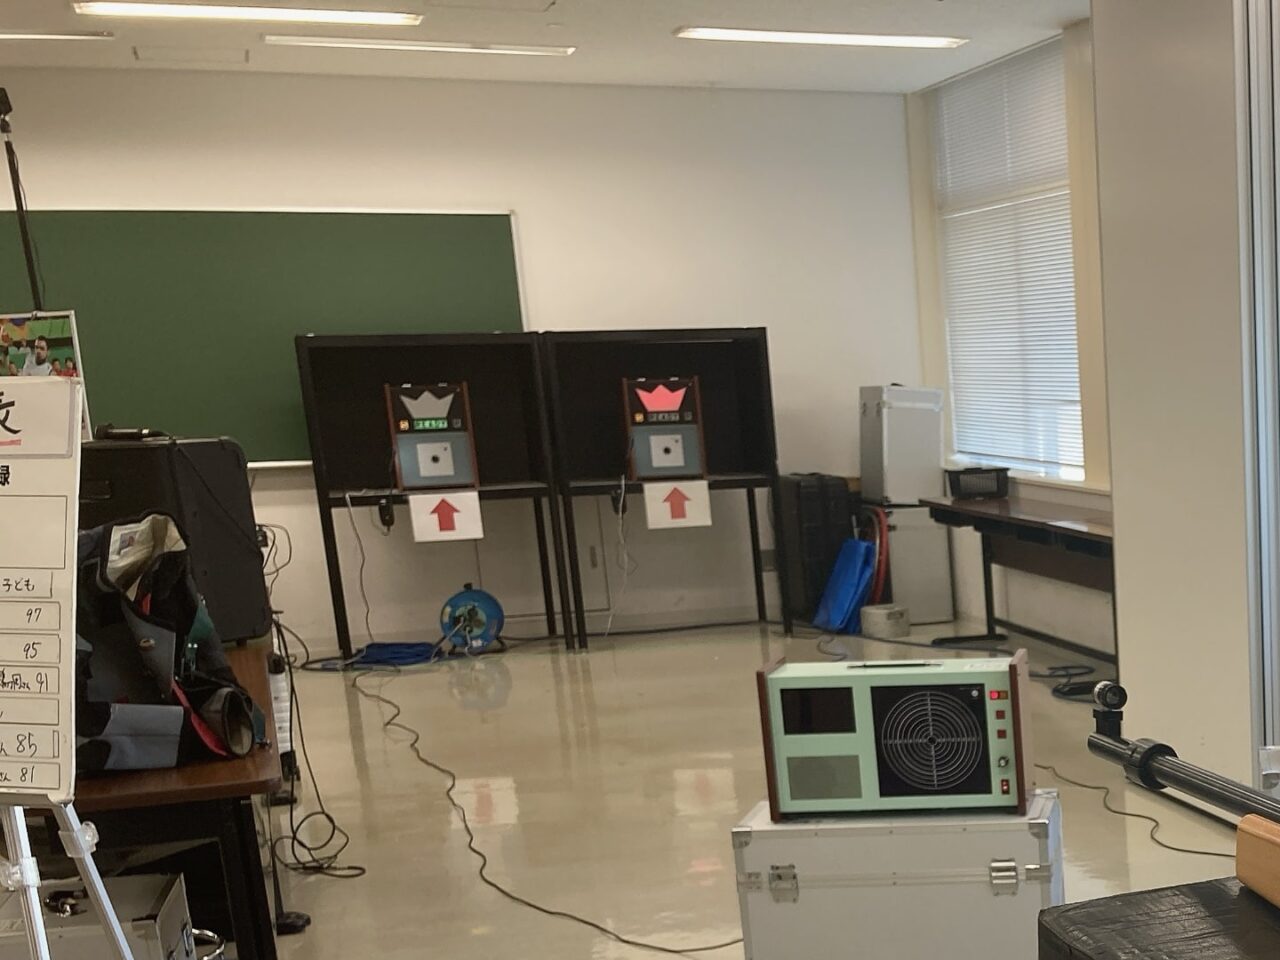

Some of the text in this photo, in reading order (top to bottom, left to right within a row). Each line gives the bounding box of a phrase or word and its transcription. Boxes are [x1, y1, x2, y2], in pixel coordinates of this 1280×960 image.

[26, 607, 42, 623] 97
[23, 641, 42, 660] 95
[36, 672, 48, 694] 91
[16, 731, 38, 758] 85
[20, 765, 35, 783] 81
